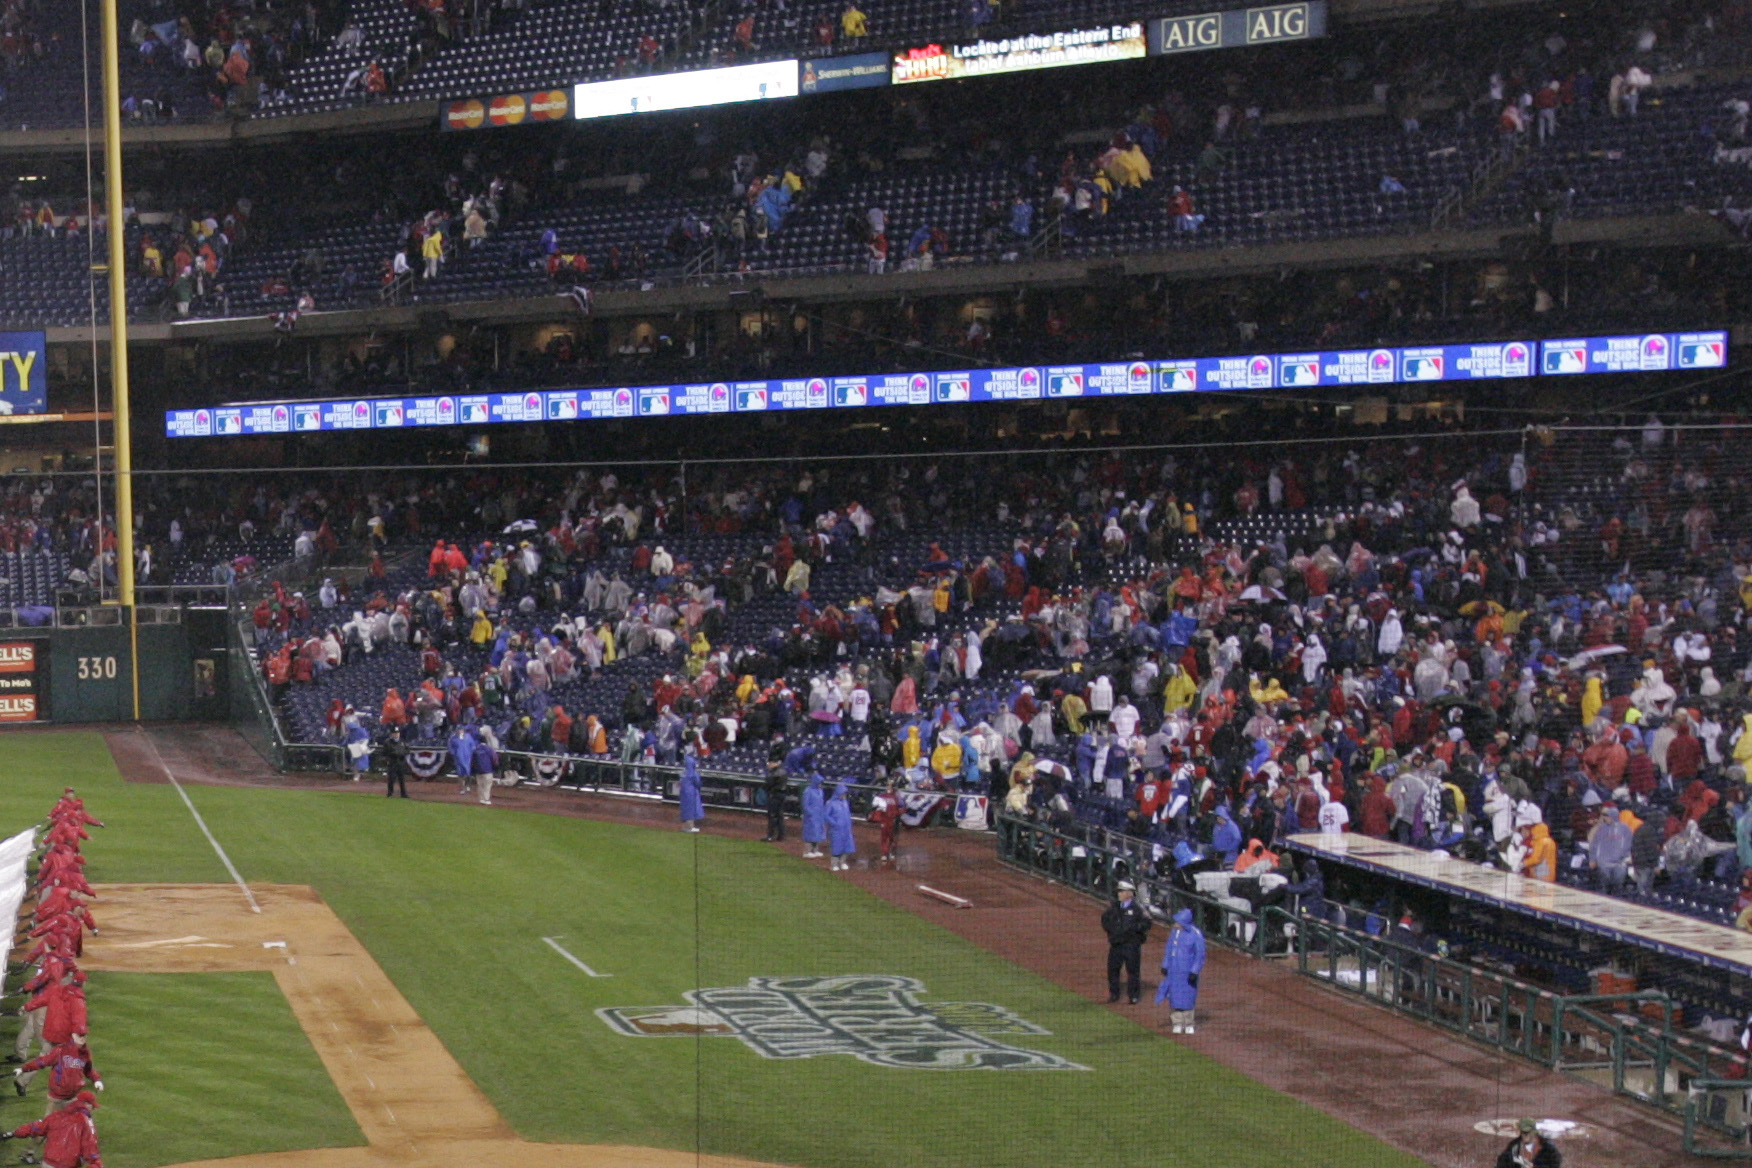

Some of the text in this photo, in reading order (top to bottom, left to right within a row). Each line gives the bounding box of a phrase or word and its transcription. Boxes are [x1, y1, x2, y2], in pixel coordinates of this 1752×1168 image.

[1251, 8, 1304, 39] AIG
[1111, 24, 1141, 41] End
[1166, 18, 1217, 48] AIG
[1338, 353, 1367, 364] THINK
[1219, 360, 1247, 369] THINK
[1325, 364, 1367, 376] OUTSIDE
[1100, 365, 1127, 376] THINK
[1207, 370, 1247, 381] OUTSIDE
[1089, 376, 1127, 387] OUTSIDE
[77, 656, 118, 680] 330
